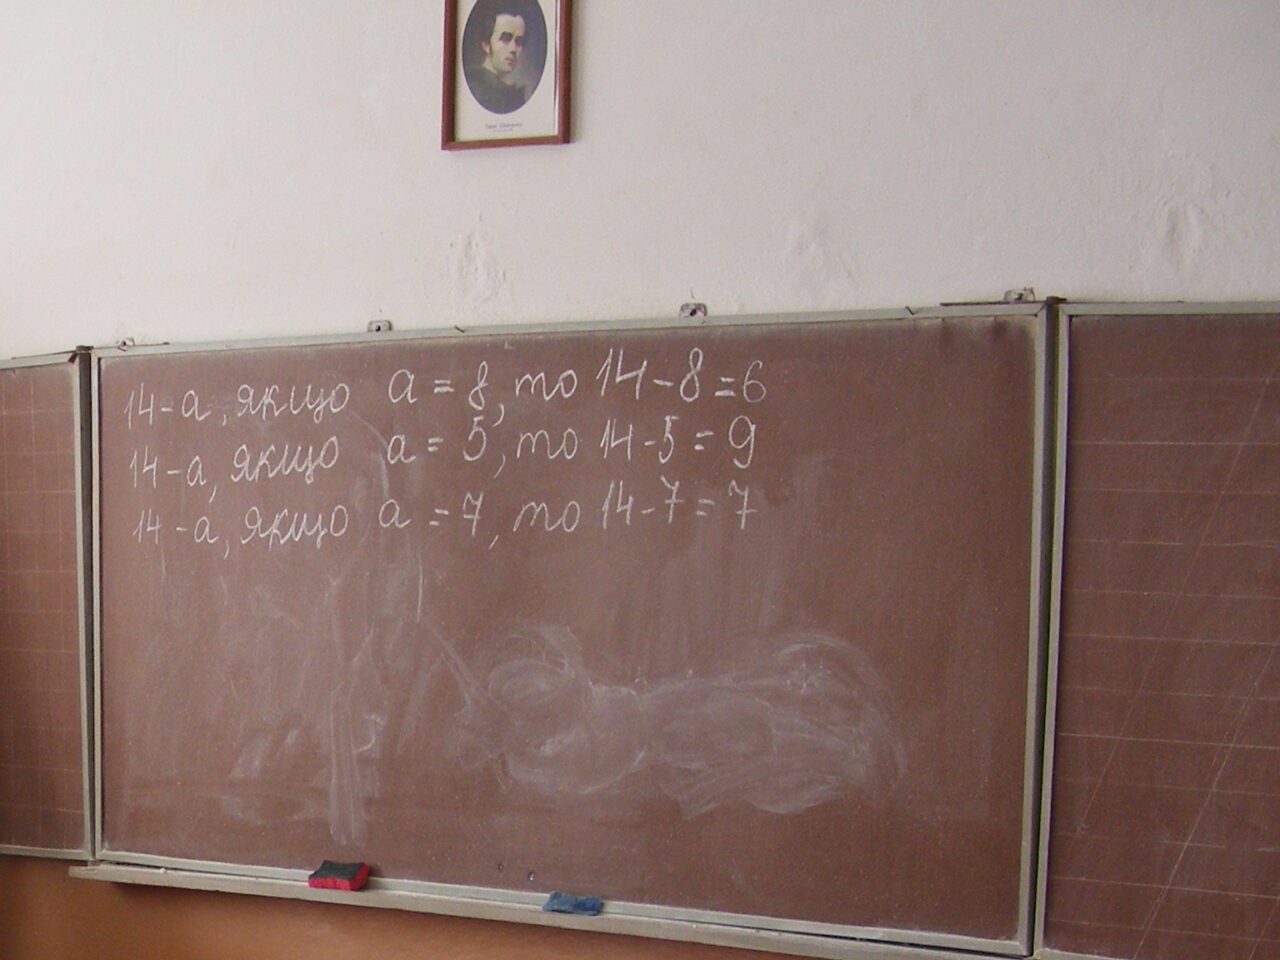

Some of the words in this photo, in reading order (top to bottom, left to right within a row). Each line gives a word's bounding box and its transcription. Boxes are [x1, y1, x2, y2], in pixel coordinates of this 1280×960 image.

[236, 383, 350, 424] якщо
[515, 369, 578, 401] то
[230, 436, 339, 484] якщо
[516, 428, 578, 460] то
[239, 504, 349, 550] якщо
[512, 500, 581, 533] то
